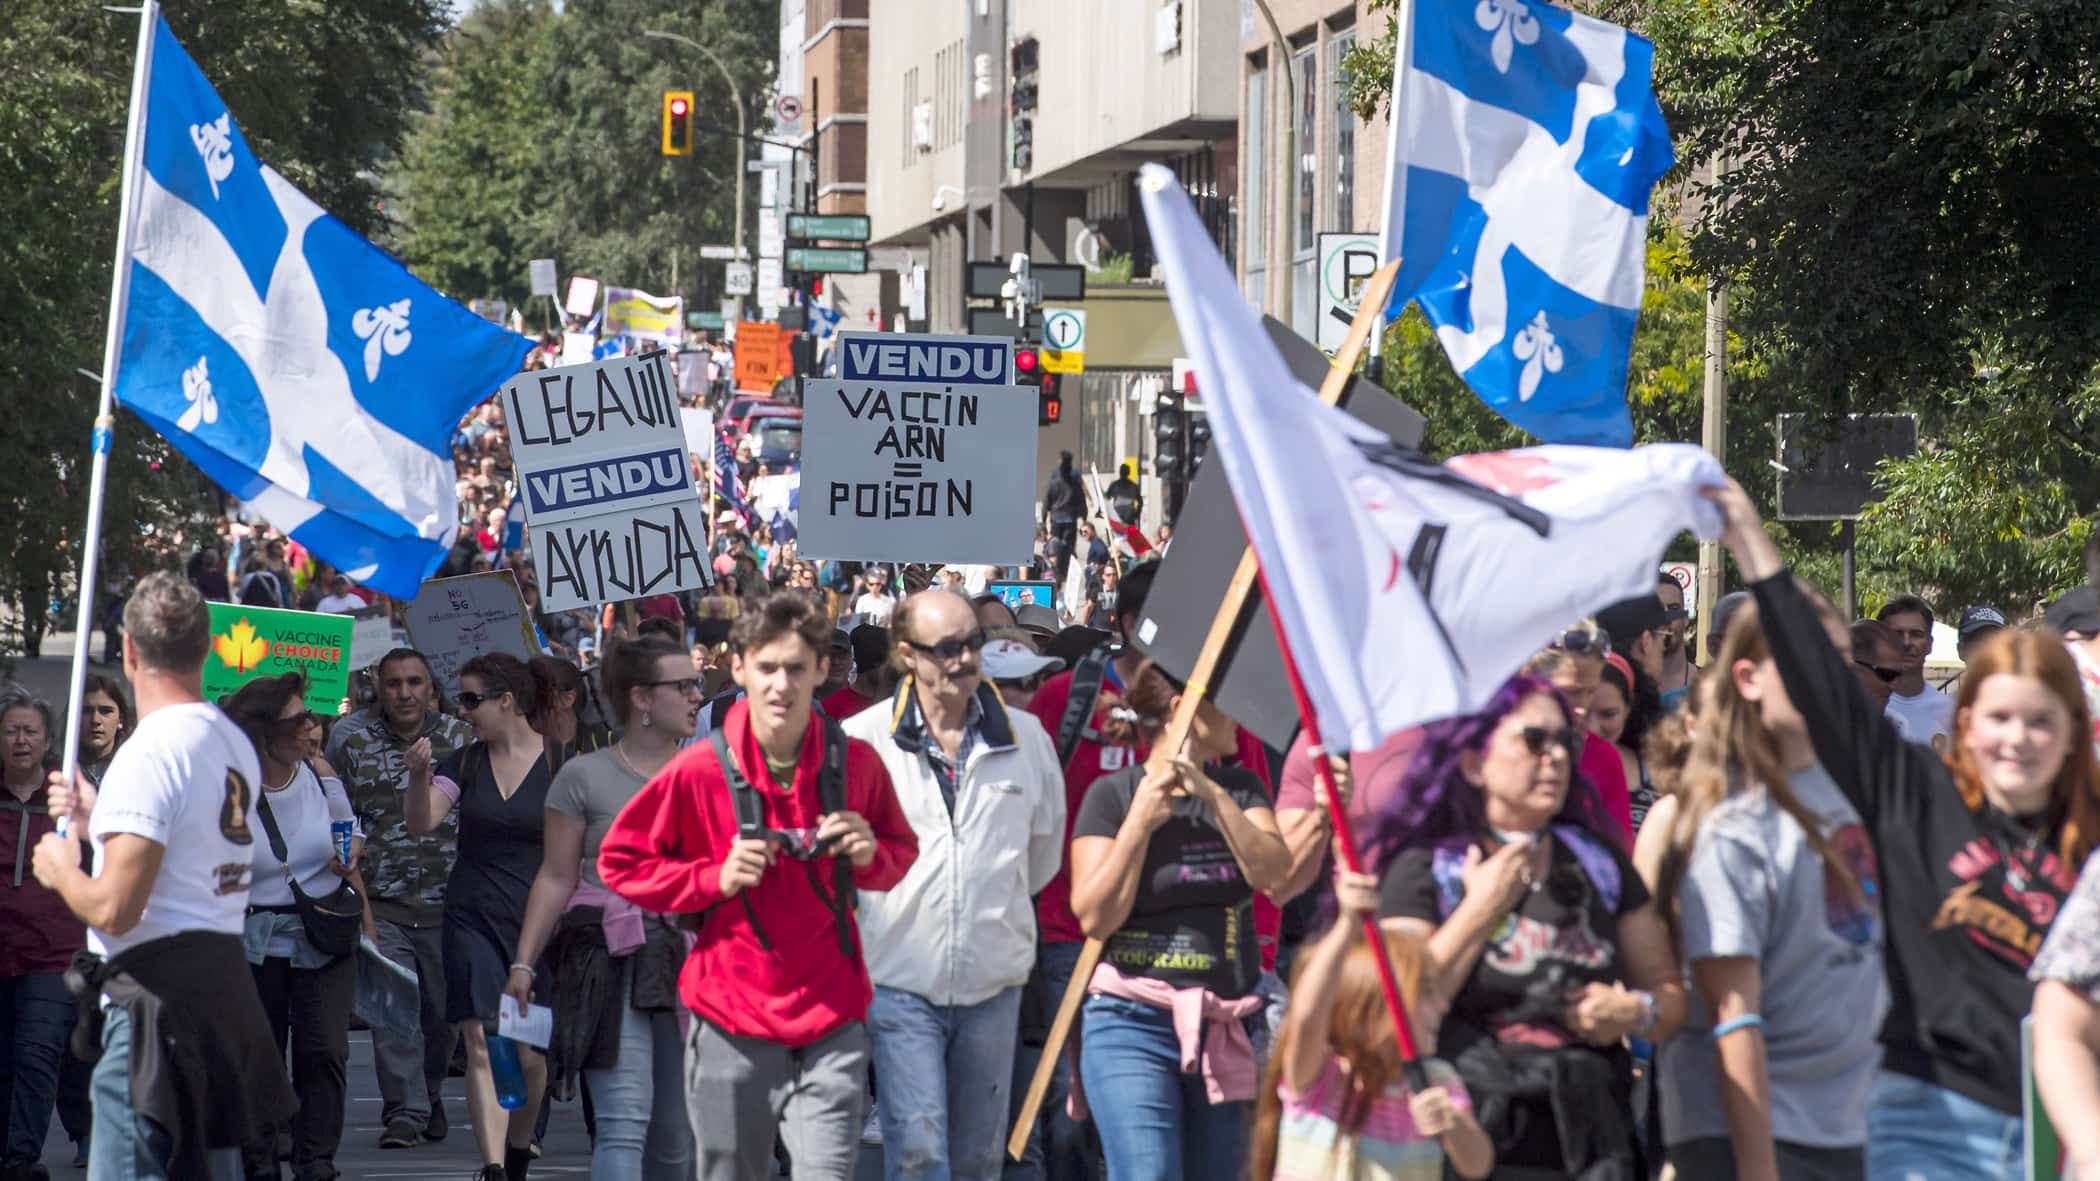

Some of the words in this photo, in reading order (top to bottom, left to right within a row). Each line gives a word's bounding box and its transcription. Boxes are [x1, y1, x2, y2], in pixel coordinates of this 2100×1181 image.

[1343, 249, 1378, 300] P
[849, 343, 1003, 379] VENDU
[874, 424, 945, 462] ARN
[530, 454, 683, 507] VENDU
[452, 600, 469, 611] 5G
[274, 629, 342, 648] VACCINE
[273, 643, 340, 662] CHOICE
[273, 656, 339, 673] CANADA
